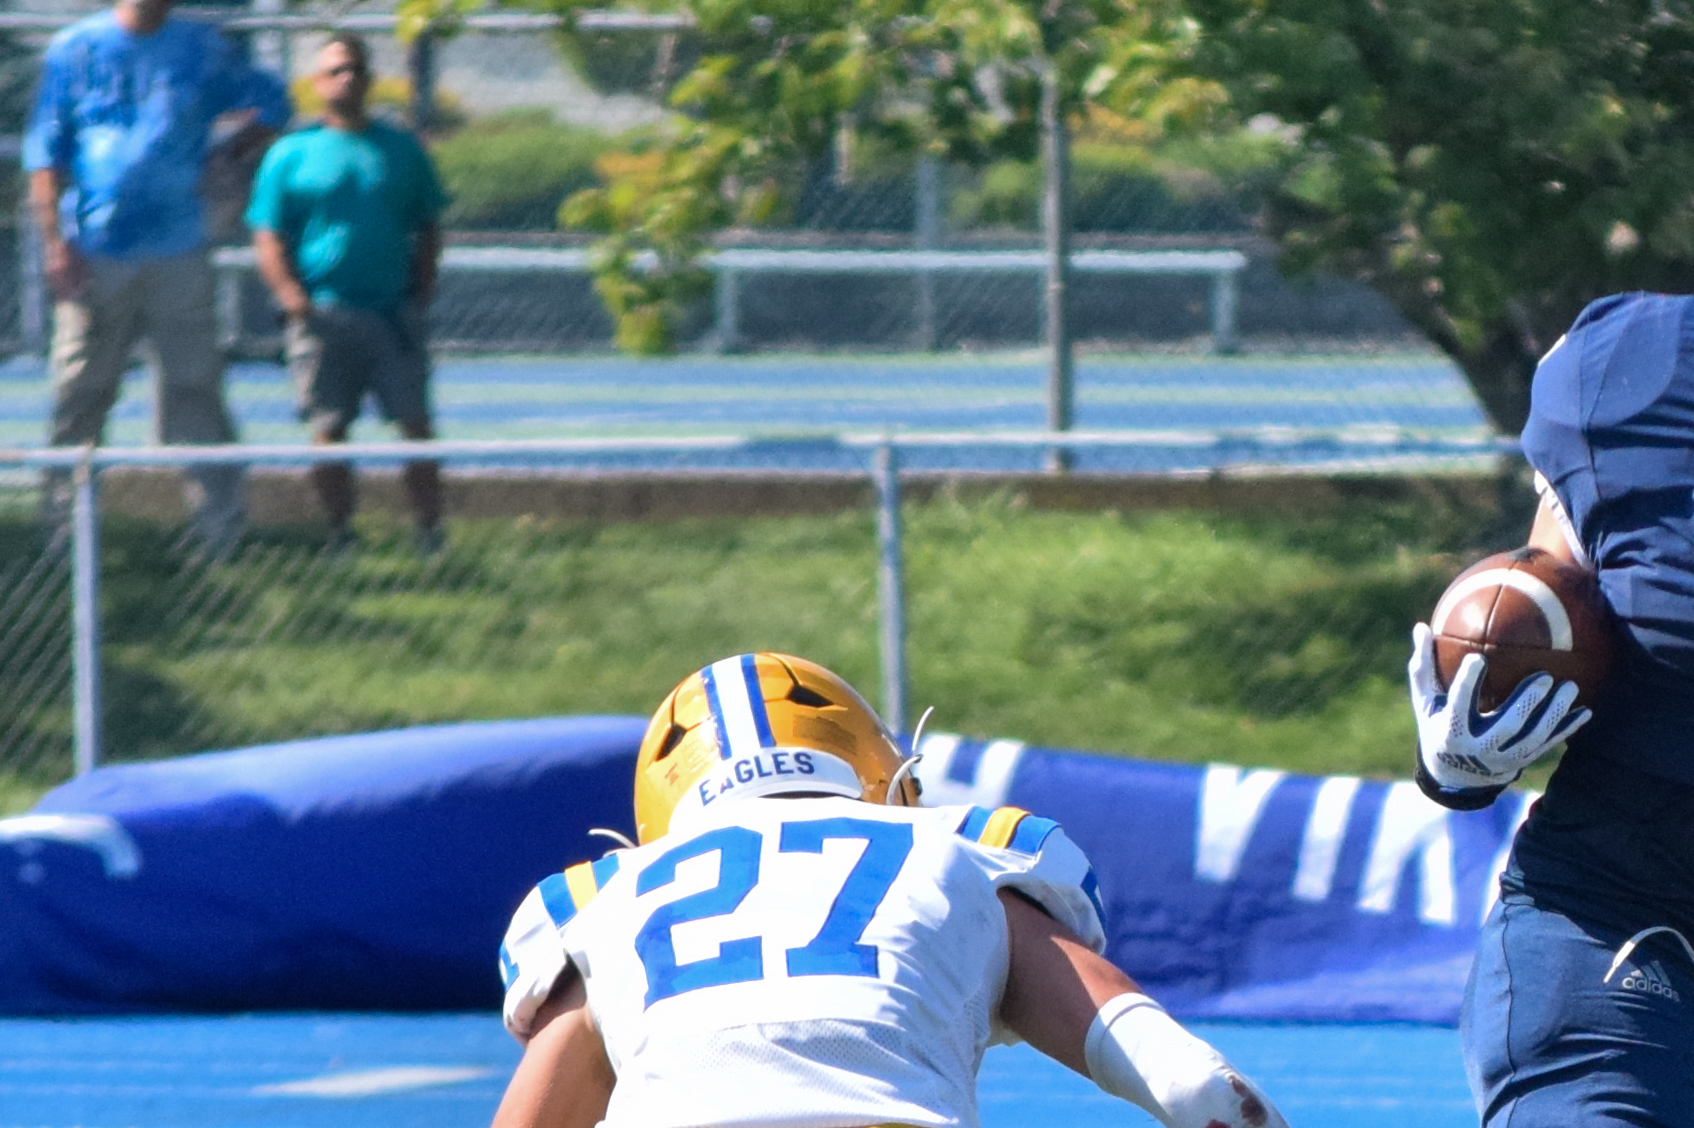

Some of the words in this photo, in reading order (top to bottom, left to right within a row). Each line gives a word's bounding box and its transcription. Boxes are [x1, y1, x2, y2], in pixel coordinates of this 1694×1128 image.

[698, 751, 816, 807] EAGLES
[634, 816, 914, 1014] 27
[1622, 976, 1680, 1003] adidas
